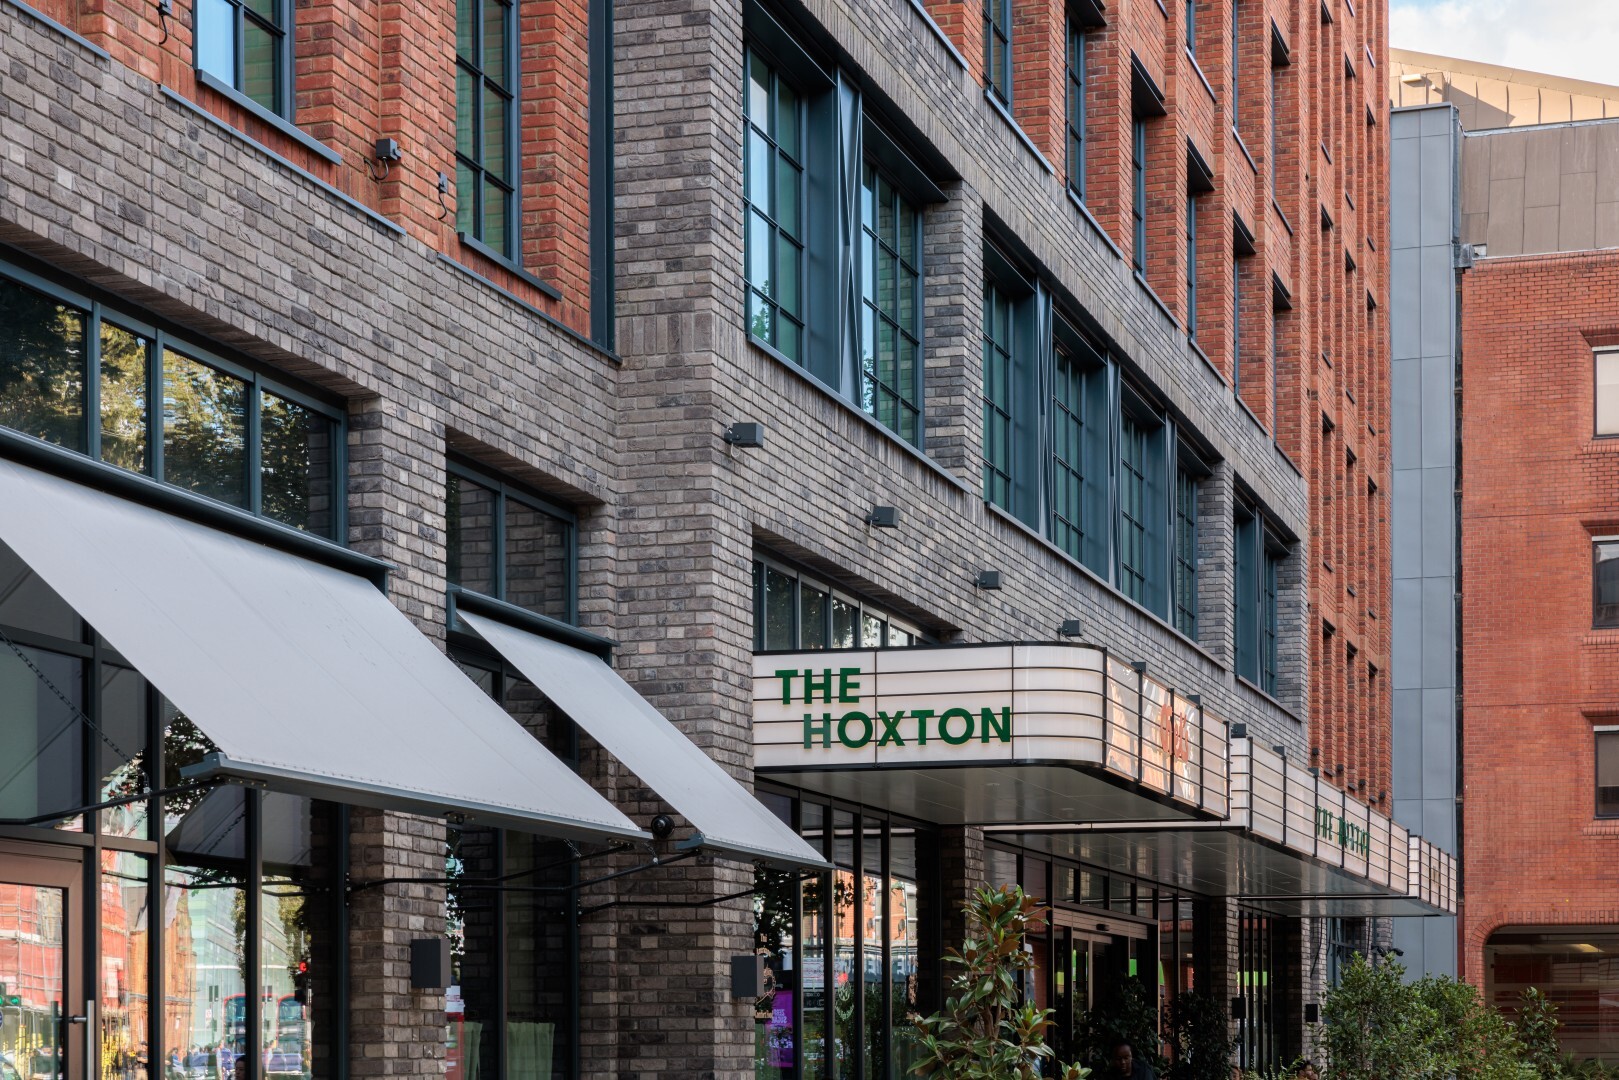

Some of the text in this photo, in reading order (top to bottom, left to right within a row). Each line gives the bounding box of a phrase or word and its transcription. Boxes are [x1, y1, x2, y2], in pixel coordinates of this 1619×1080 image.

[775, 668, 860, 704] THE
[804, 707, 1010, 749] HOXTON
[1317, 806, 1333, 840] THE
